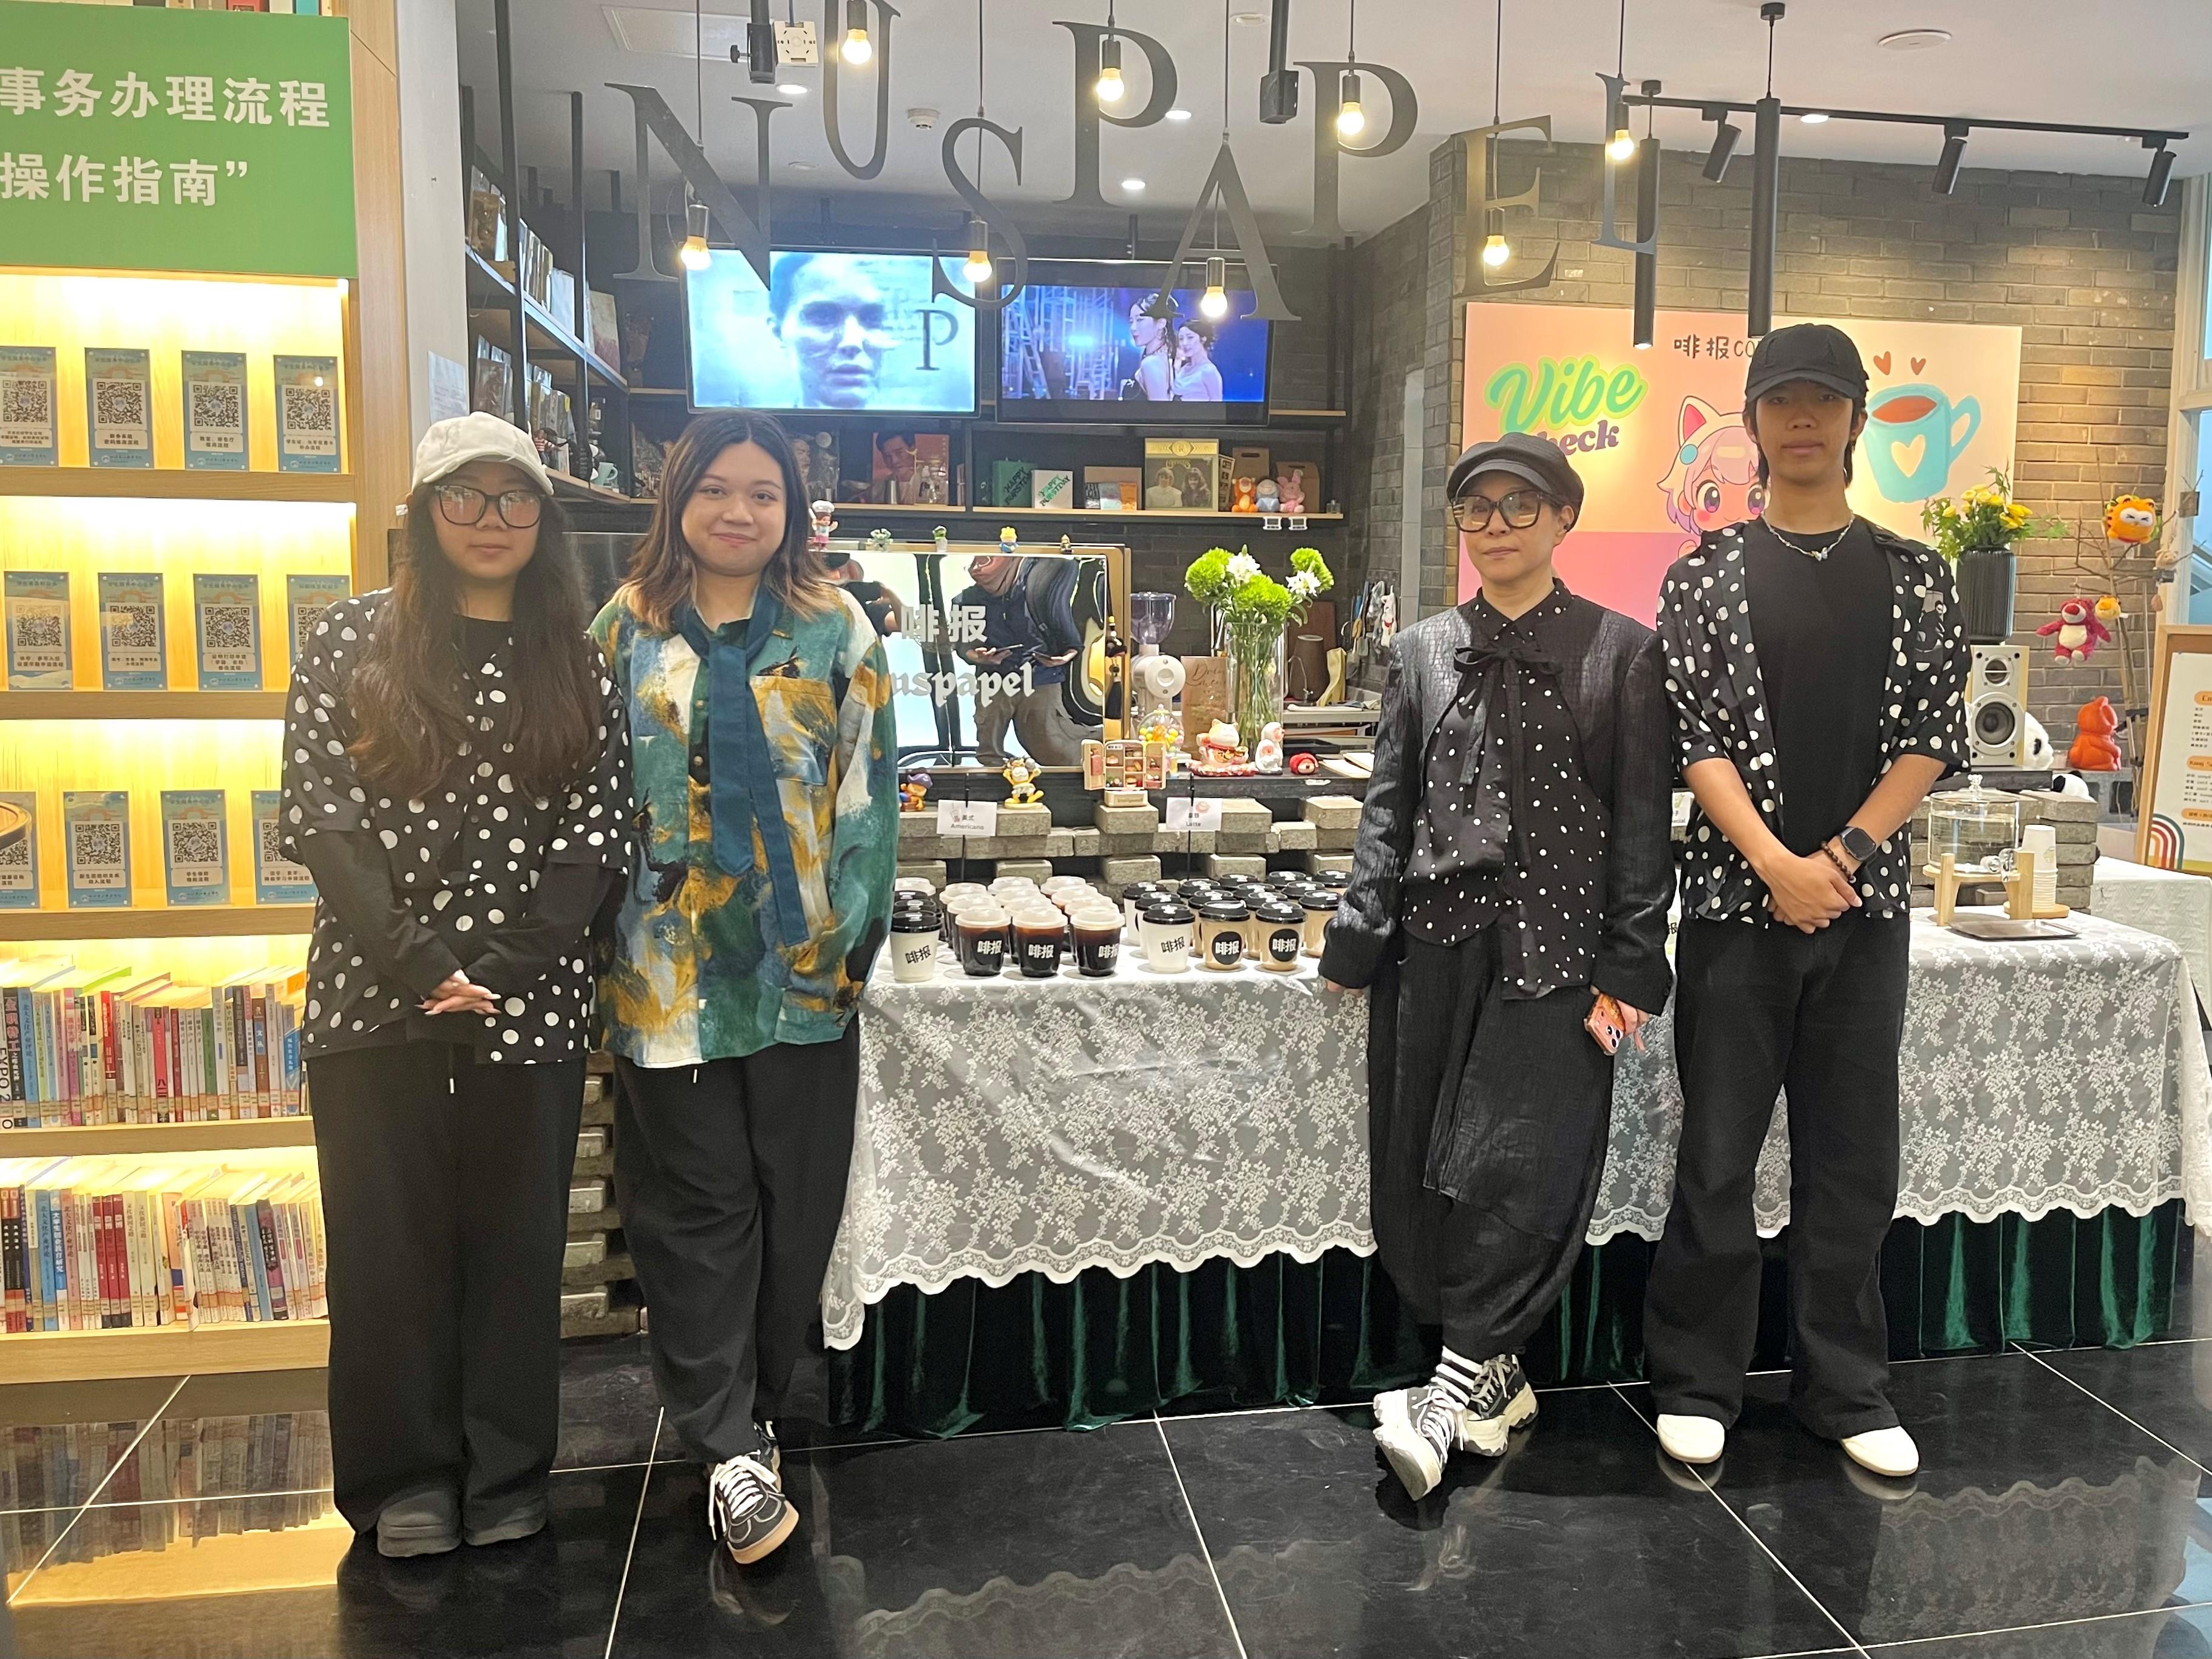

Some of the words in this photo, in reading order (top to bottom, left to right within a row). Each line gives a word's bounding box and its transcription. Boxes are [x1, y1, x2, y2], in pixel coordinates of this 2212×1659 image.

[0, 67, 330, 128] 事务办理流程
[1674, 334, 1729, 360] 啡报
[1734, 340, 1760, 358] CO
[1489, 359, 1643, 433] Vibe
[1538, 419, 1620, 456] eck
[901, 604, 988, 643] 啡报
[891, 660, 1035, 708] uspapel
[905, 945, 932, 964] 啡报
[977, 940, 1002, 955] 啡报
[1028, 944, 1054, 959] 啡报
[1161, 936, 1186, 954] 啡报
[1215, 940, 1240, 955] 啡报
[1272, 937, 1298, 953] 啡报
